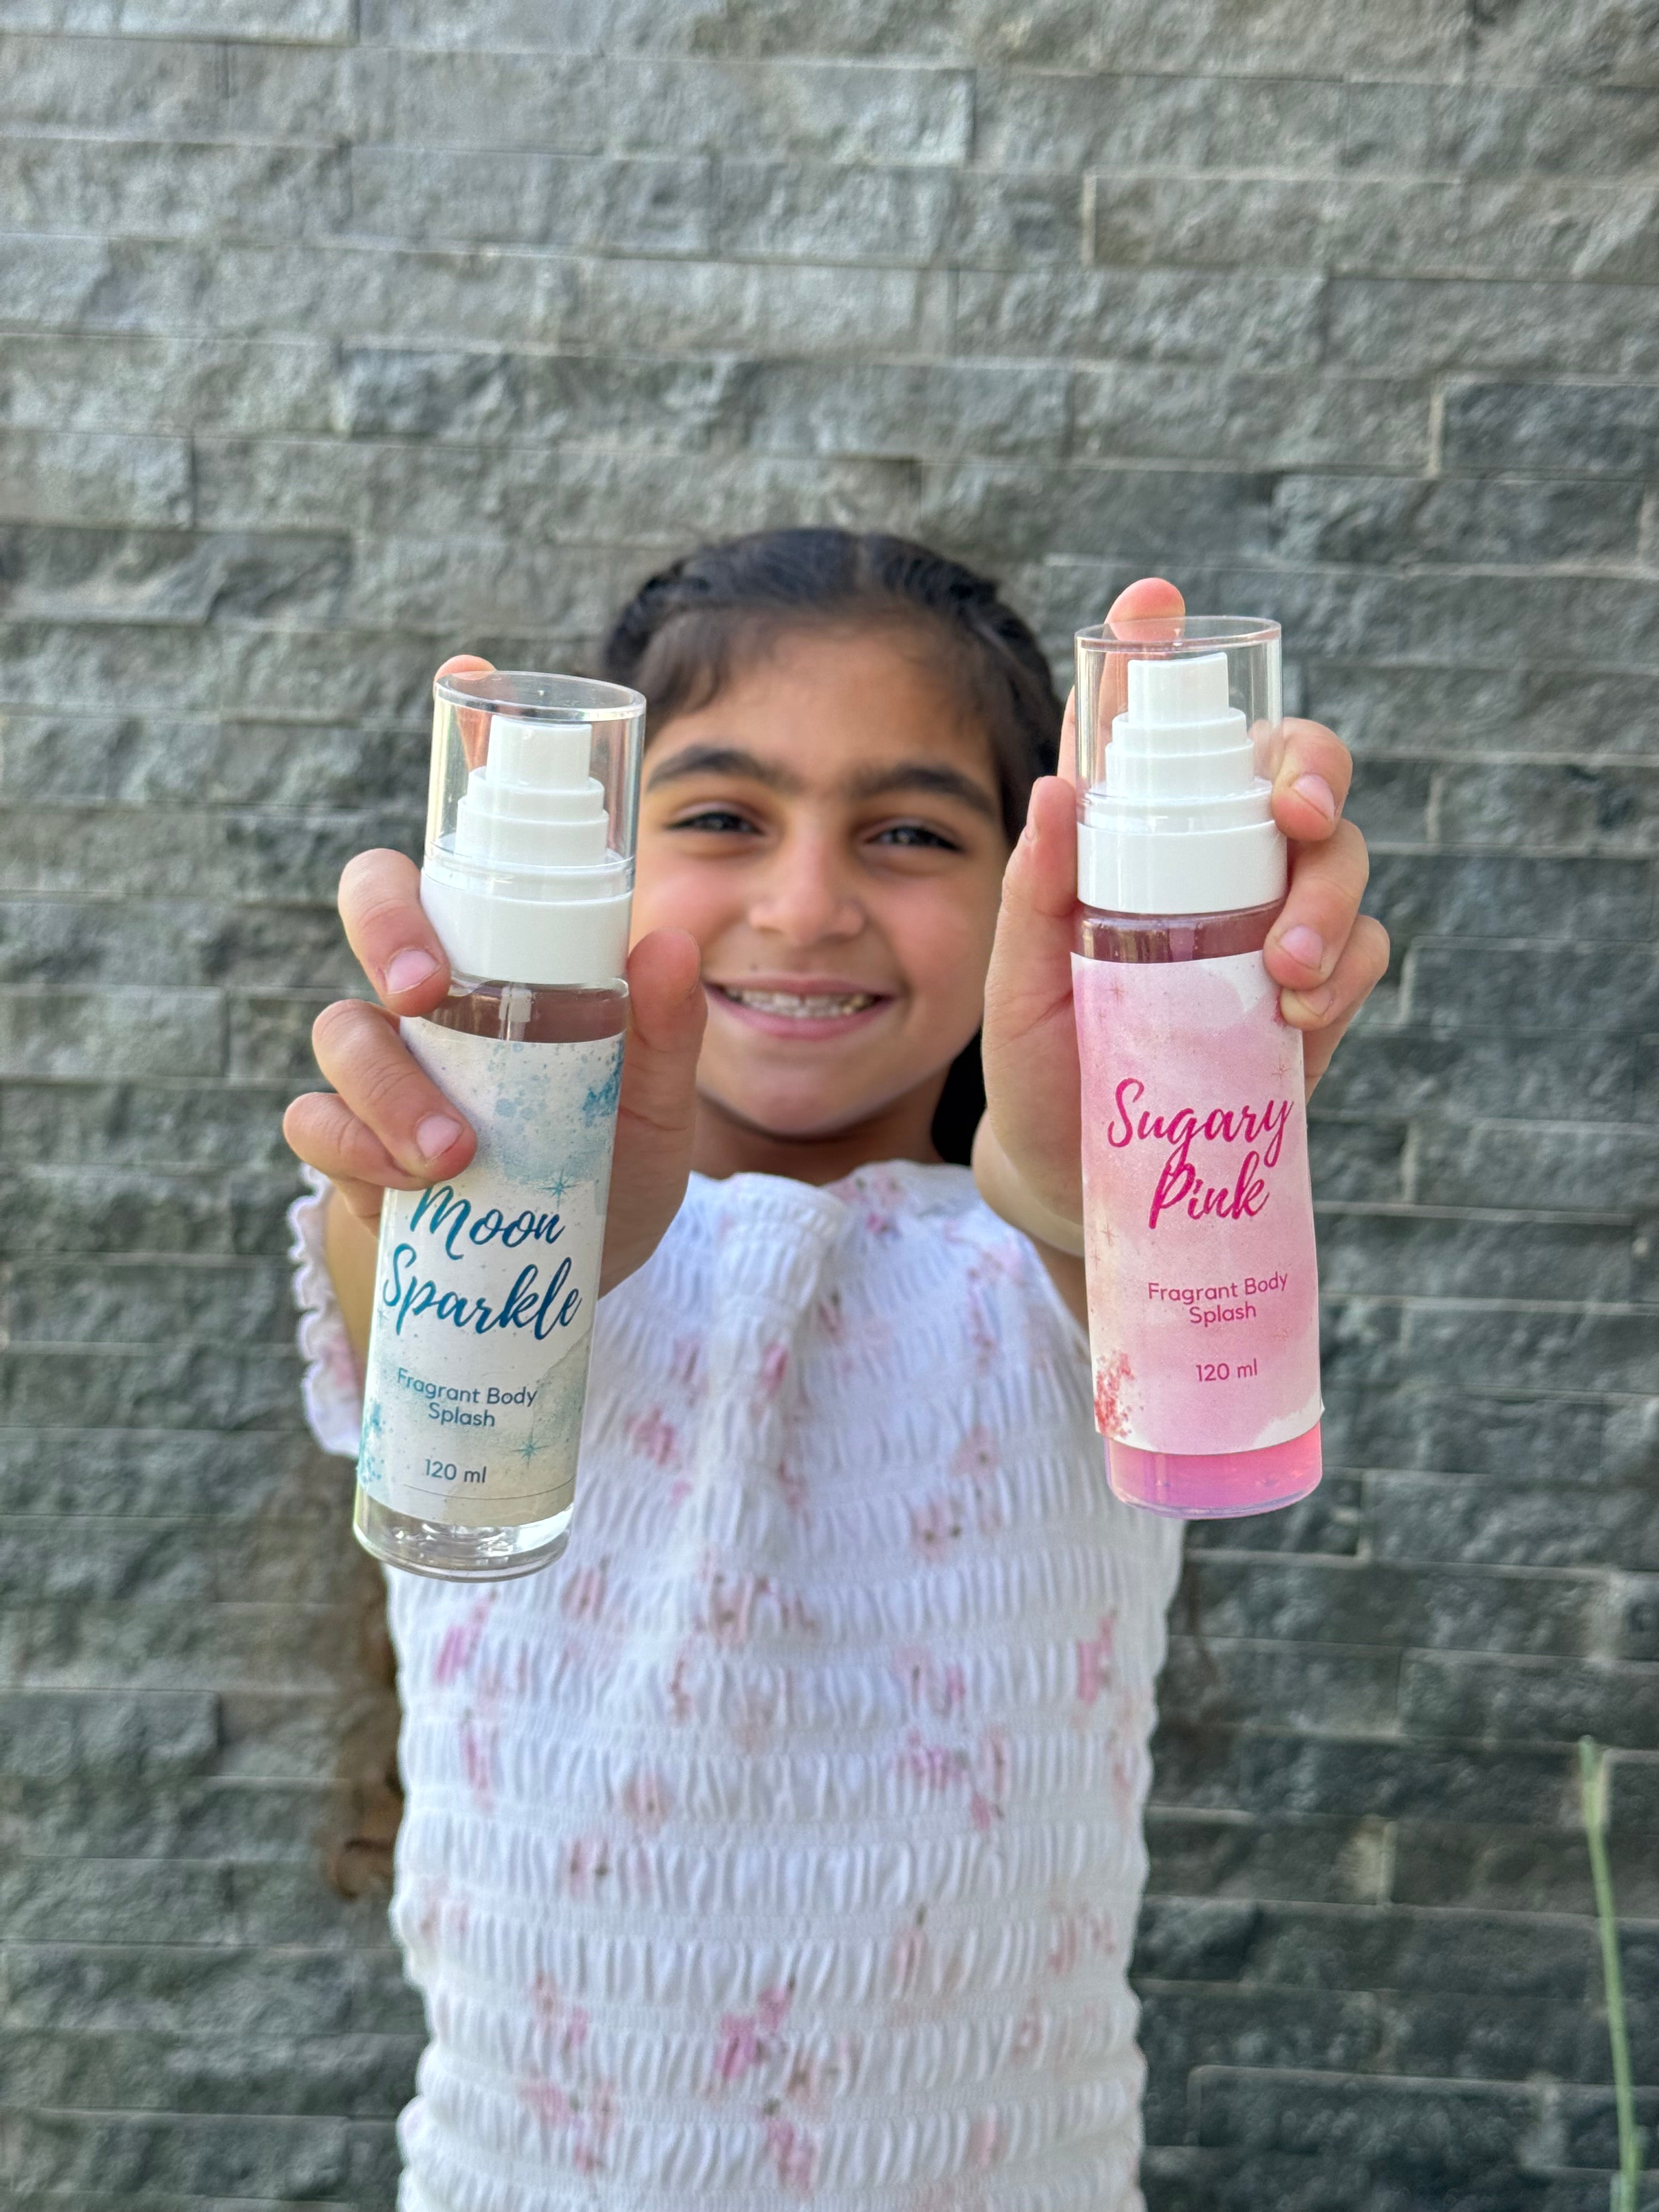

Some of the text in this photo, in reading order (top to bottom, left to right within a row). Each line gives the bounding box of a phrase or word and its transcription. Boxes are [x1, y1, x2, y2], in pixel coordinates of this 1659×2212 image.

[1108, 1077, 1294, 1176] Sugary
[1149, 1151, 1269, 1228] Pink
[410, 1186, 565, 1259] Moon
[383, 1243, 582, 1340] Sparkle
[1149, 1271, 1288, 1305] Fragrant Body
[1189, 1301, 1256, 1327] Splash
[397, 1367, 538, 1408] Fragrant Body
[1196, 1358, 1257, 1382] 120 ml
[428, 1402, 495, 1427] Splash
[426, 1459, 487, 1483] 120 ml
